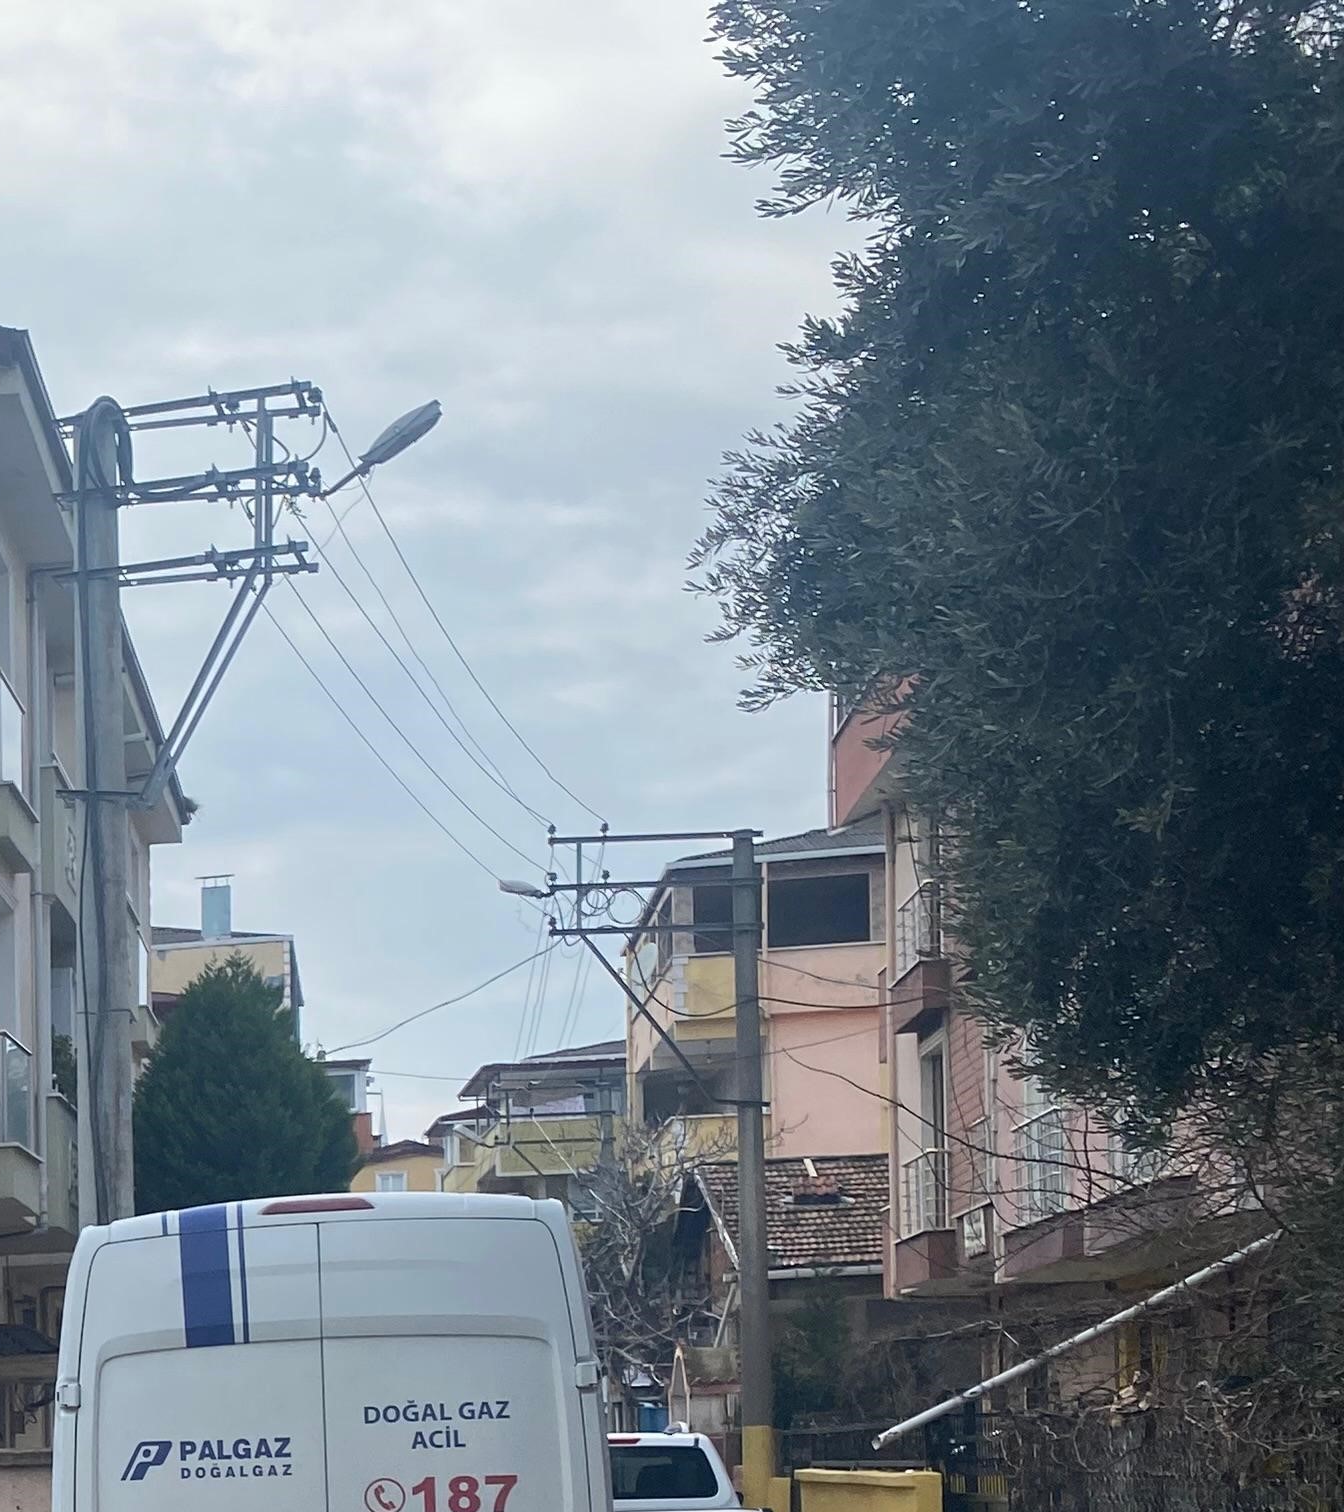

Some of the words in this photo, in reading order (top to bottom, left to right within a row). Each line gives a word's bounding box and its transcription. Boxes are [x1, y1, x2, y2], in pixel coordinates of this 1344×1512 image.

[363, 1400, 453, 1425] DOĞAL
[458, 1400, 511, 1420] GAZ
[179, 1436, 292, 1461] PALGAZ
[411, 1425, 467, 1450] ACİL
[180, 1463, 293, 1480] DOĞALGAZ
